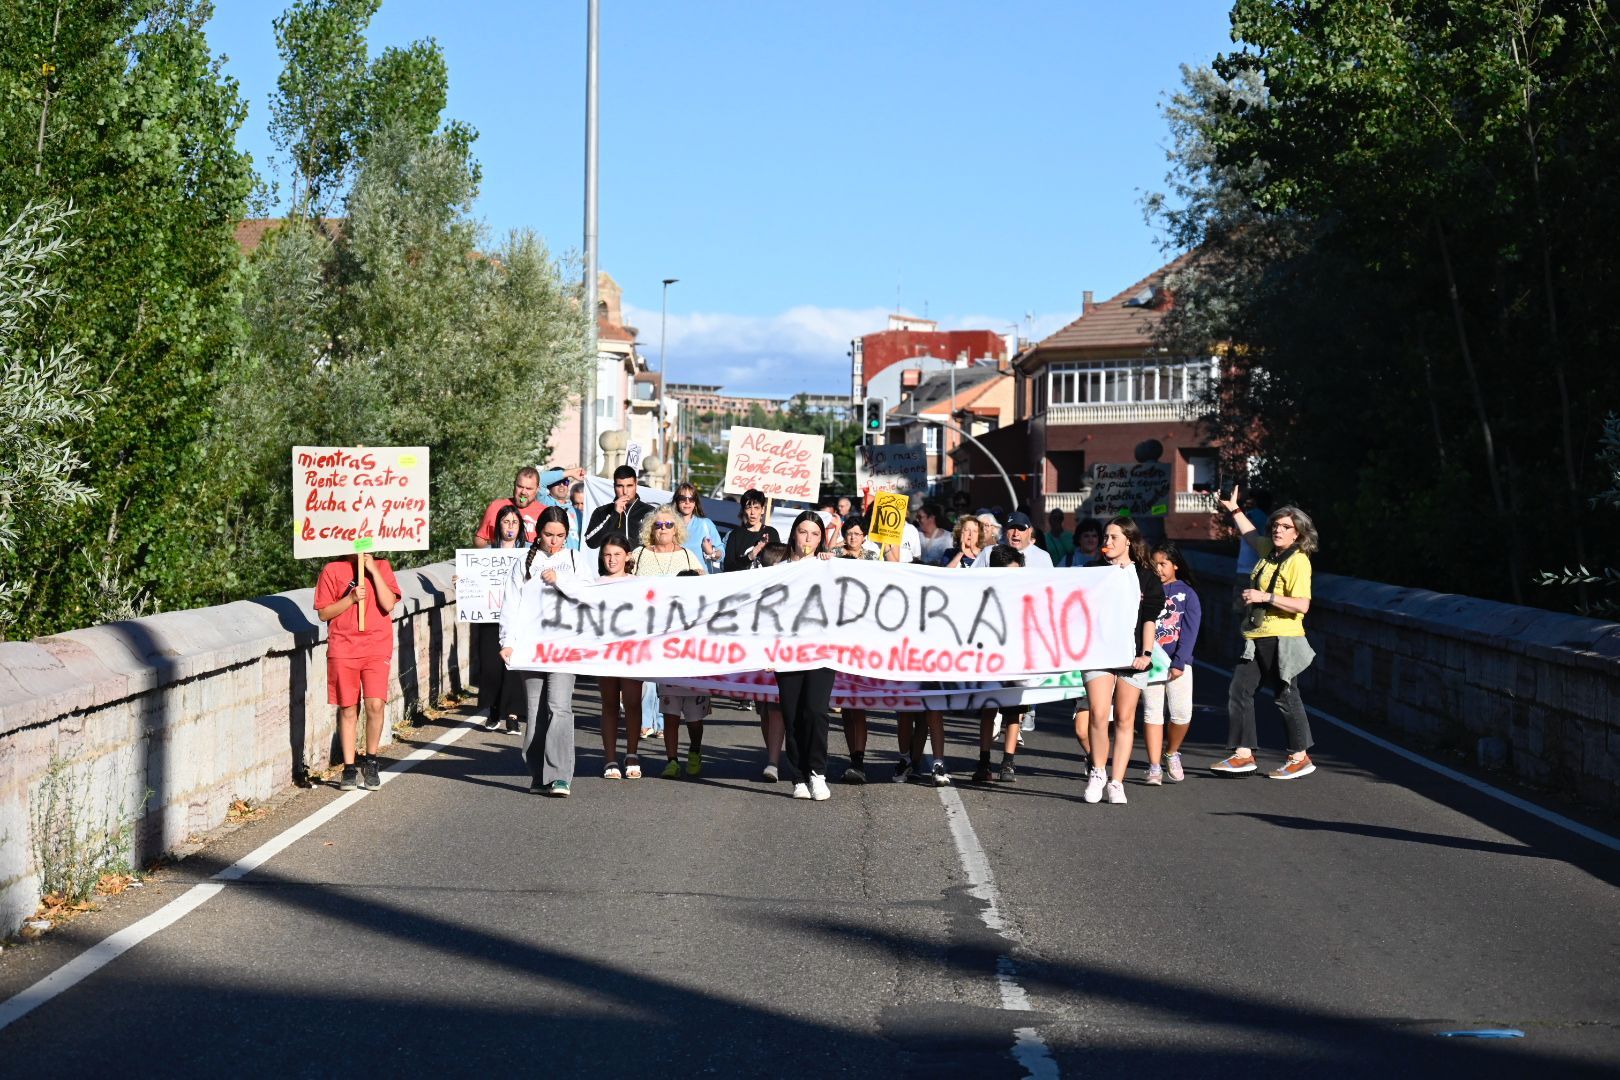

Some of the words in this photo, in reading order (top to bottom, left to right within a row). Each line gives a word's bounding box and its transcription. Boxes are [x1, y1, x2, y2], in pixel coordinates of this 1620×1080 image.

[741, 433, 811, 461] Alcalde
[305, 469, 348, 488] Puente
[353, 465, 408, 487] Castro
[734, 453, 771, 474] Puente
[773, 461, 811, 478] Castro
[785, 480, 811, 497] arde
[305, 488, 347, 512] lucha
[382, 496, 426, 517] quien
[876, 506, 898, 528] NO
[378, 517, 426, 543] hucha?
[460, 610, 467, 620] A
[471, 610, 484, 621] LA
[1023, 586, 1092, 670] NO
[663, 637, 746, 664] SALUD
